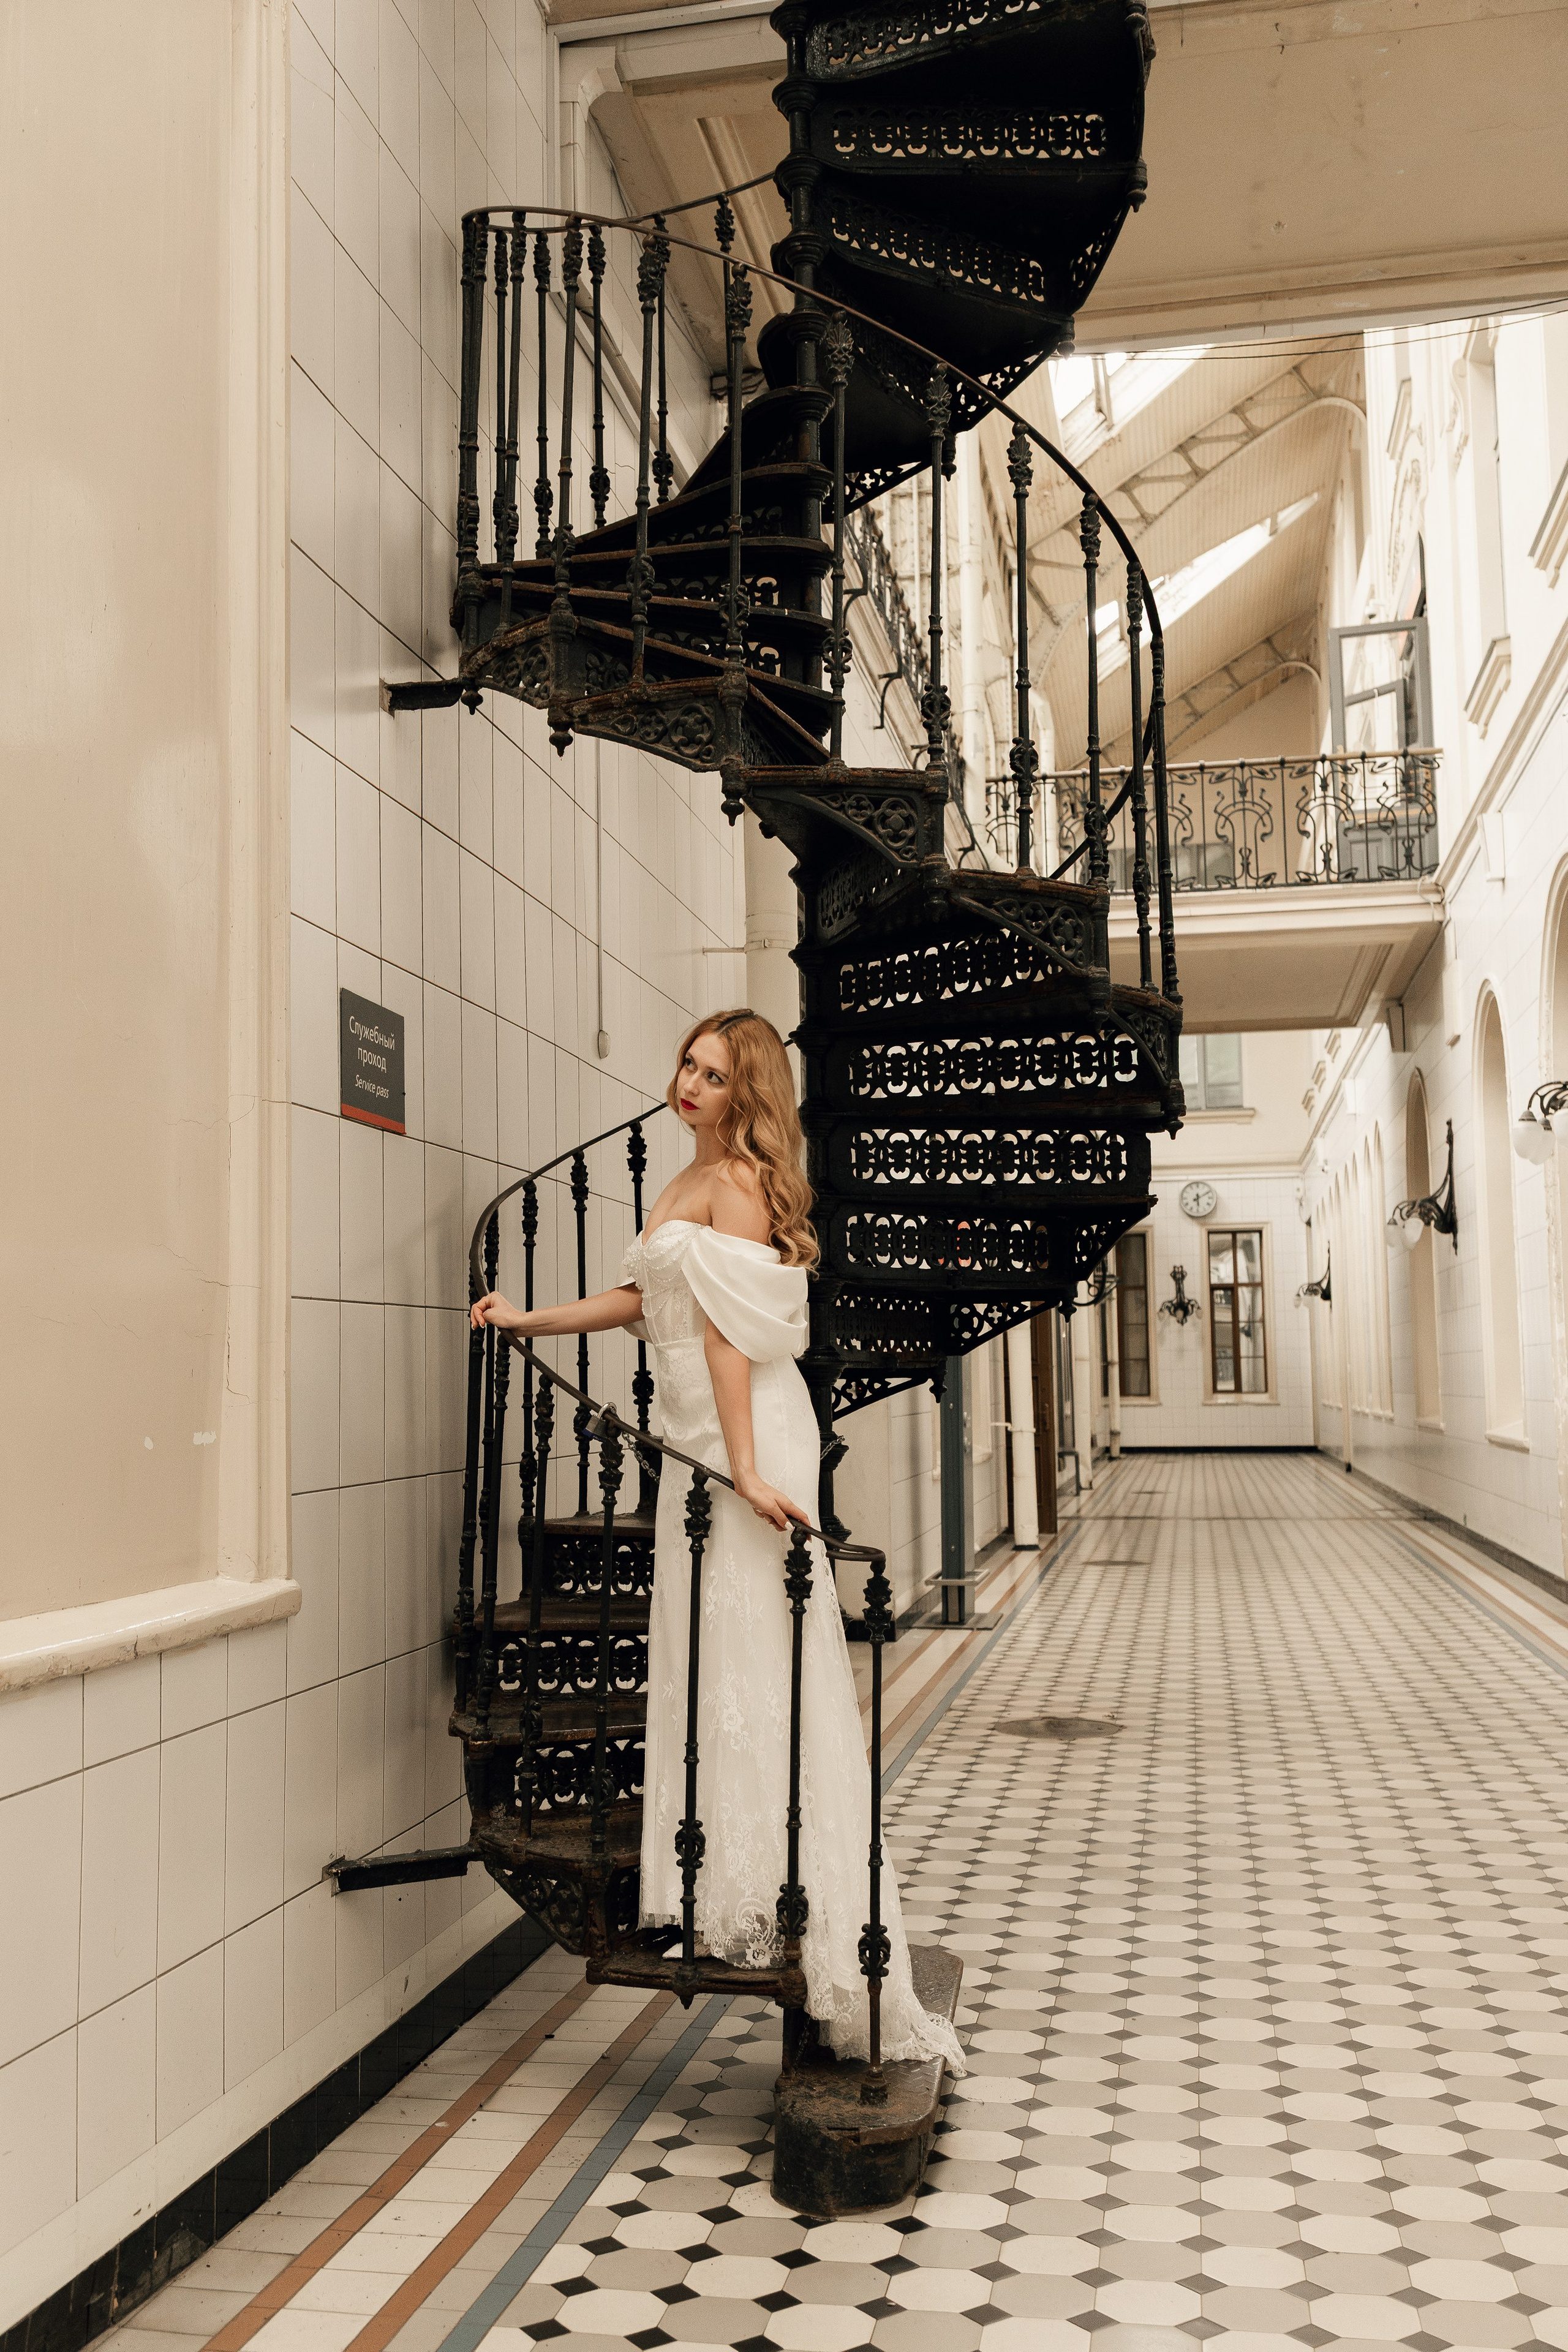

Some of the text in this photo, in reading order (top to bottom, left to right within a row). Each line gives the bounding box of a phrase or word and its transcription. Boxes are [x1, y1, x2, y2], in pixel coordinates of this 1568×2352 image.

[349, 1016, 395, 1050] Служебный
[358, 1047, 386, 1073] проход
[355, 1074, 389, 1098] Service pass
